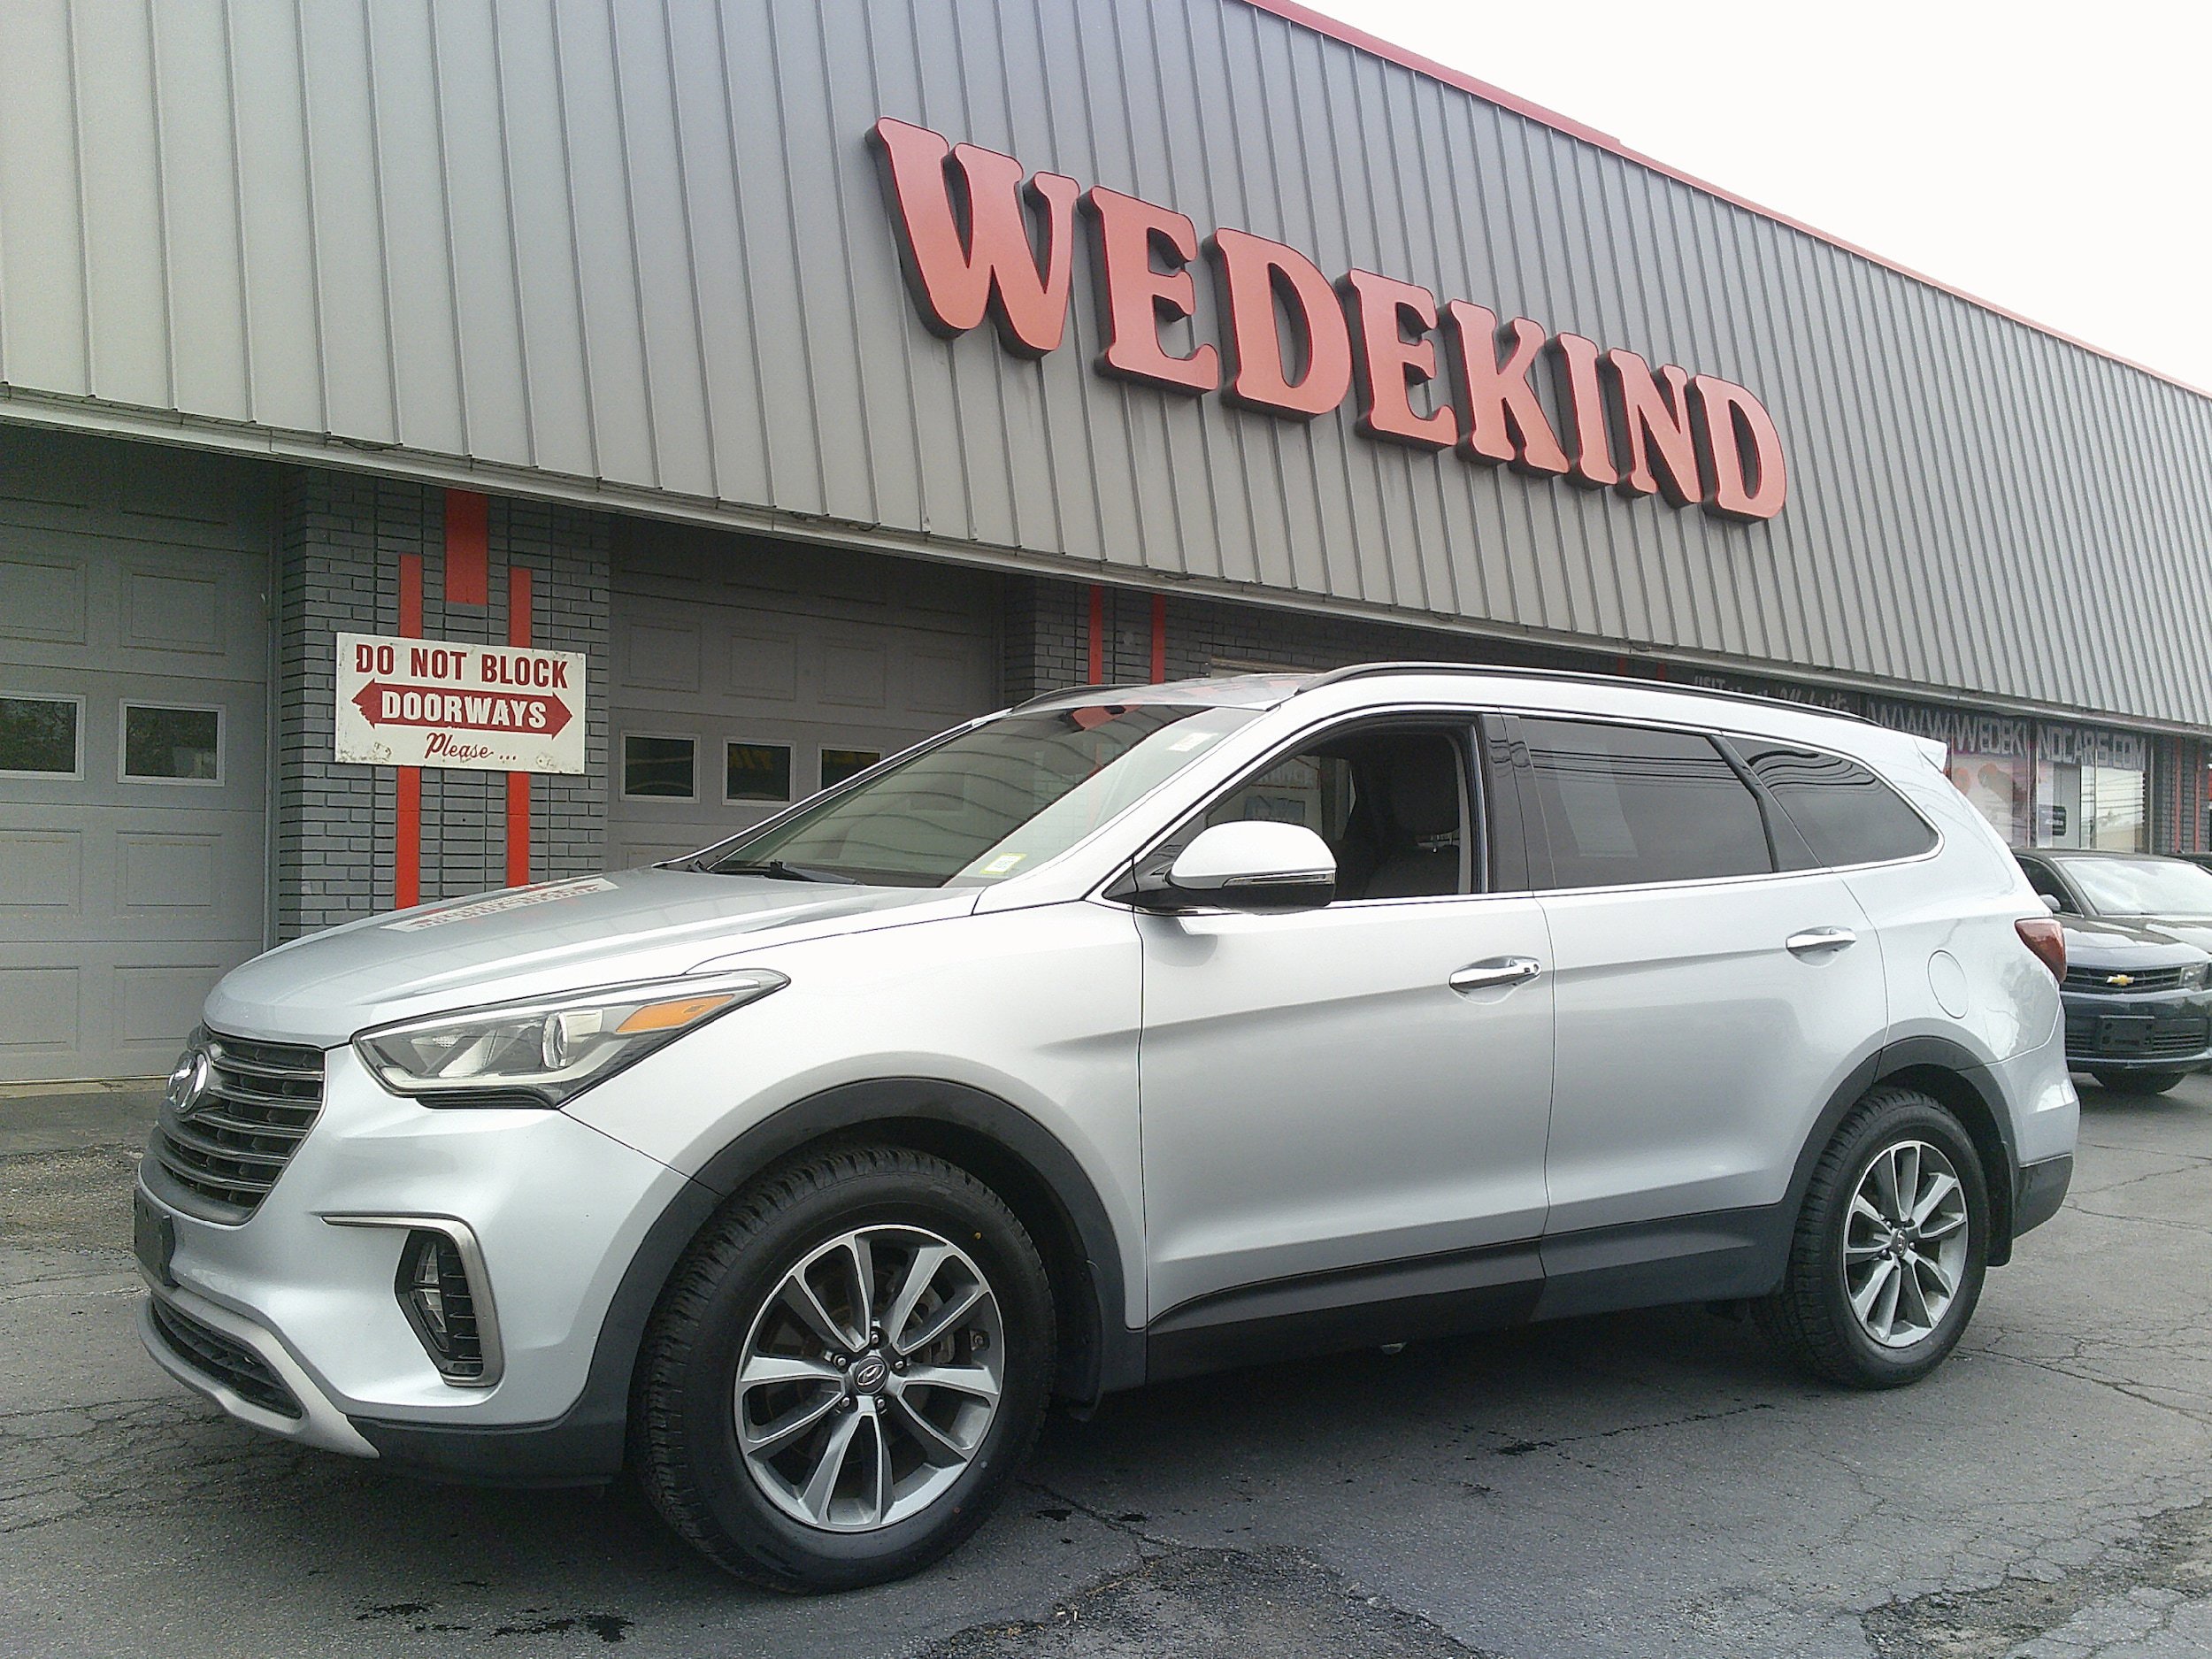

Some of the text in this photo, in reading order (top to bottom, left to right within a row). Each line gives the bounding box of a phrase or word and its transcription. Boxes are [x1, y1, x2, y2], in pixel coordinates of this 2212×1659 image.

[867, 117, 1787, 520] WEDEKIND
[356, 644, 568, 689] DO NOT BLOCK
[381, 690, 547, 728] DOORWAYS
